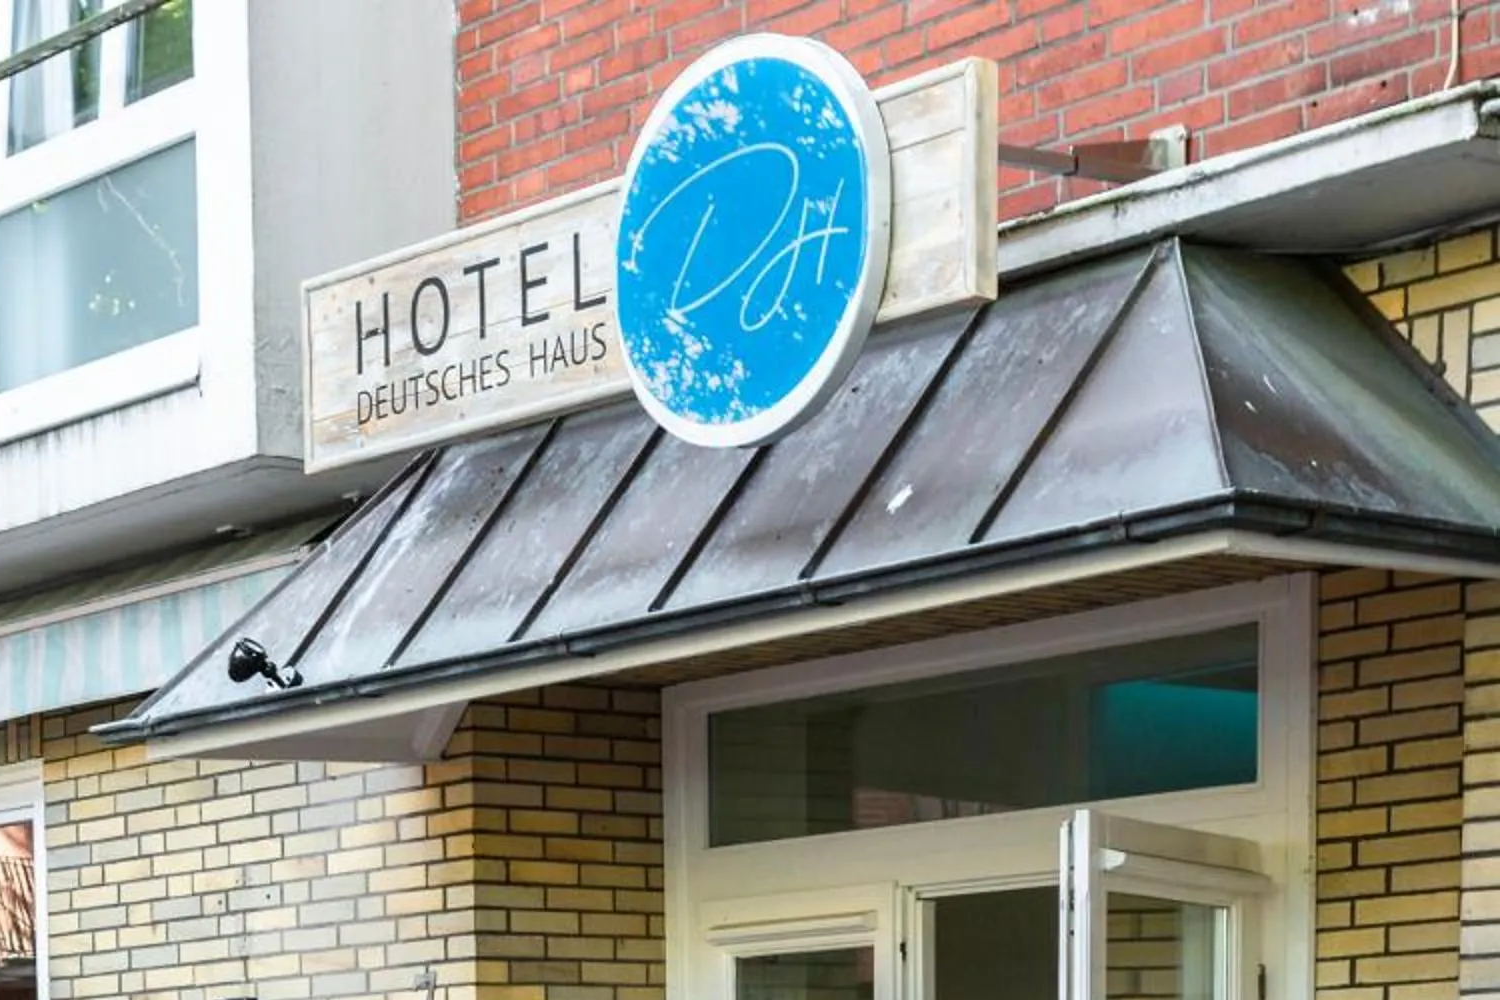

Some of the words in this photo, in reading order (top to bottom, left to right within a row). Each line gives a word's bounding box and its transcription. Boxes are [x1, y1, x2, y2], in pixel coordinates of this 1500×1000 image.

[355, 231, 607, 375] HOTEL
[356, 351, 511, 426] DEUTSCHES
[529, 323, 607, 378] HAUS
